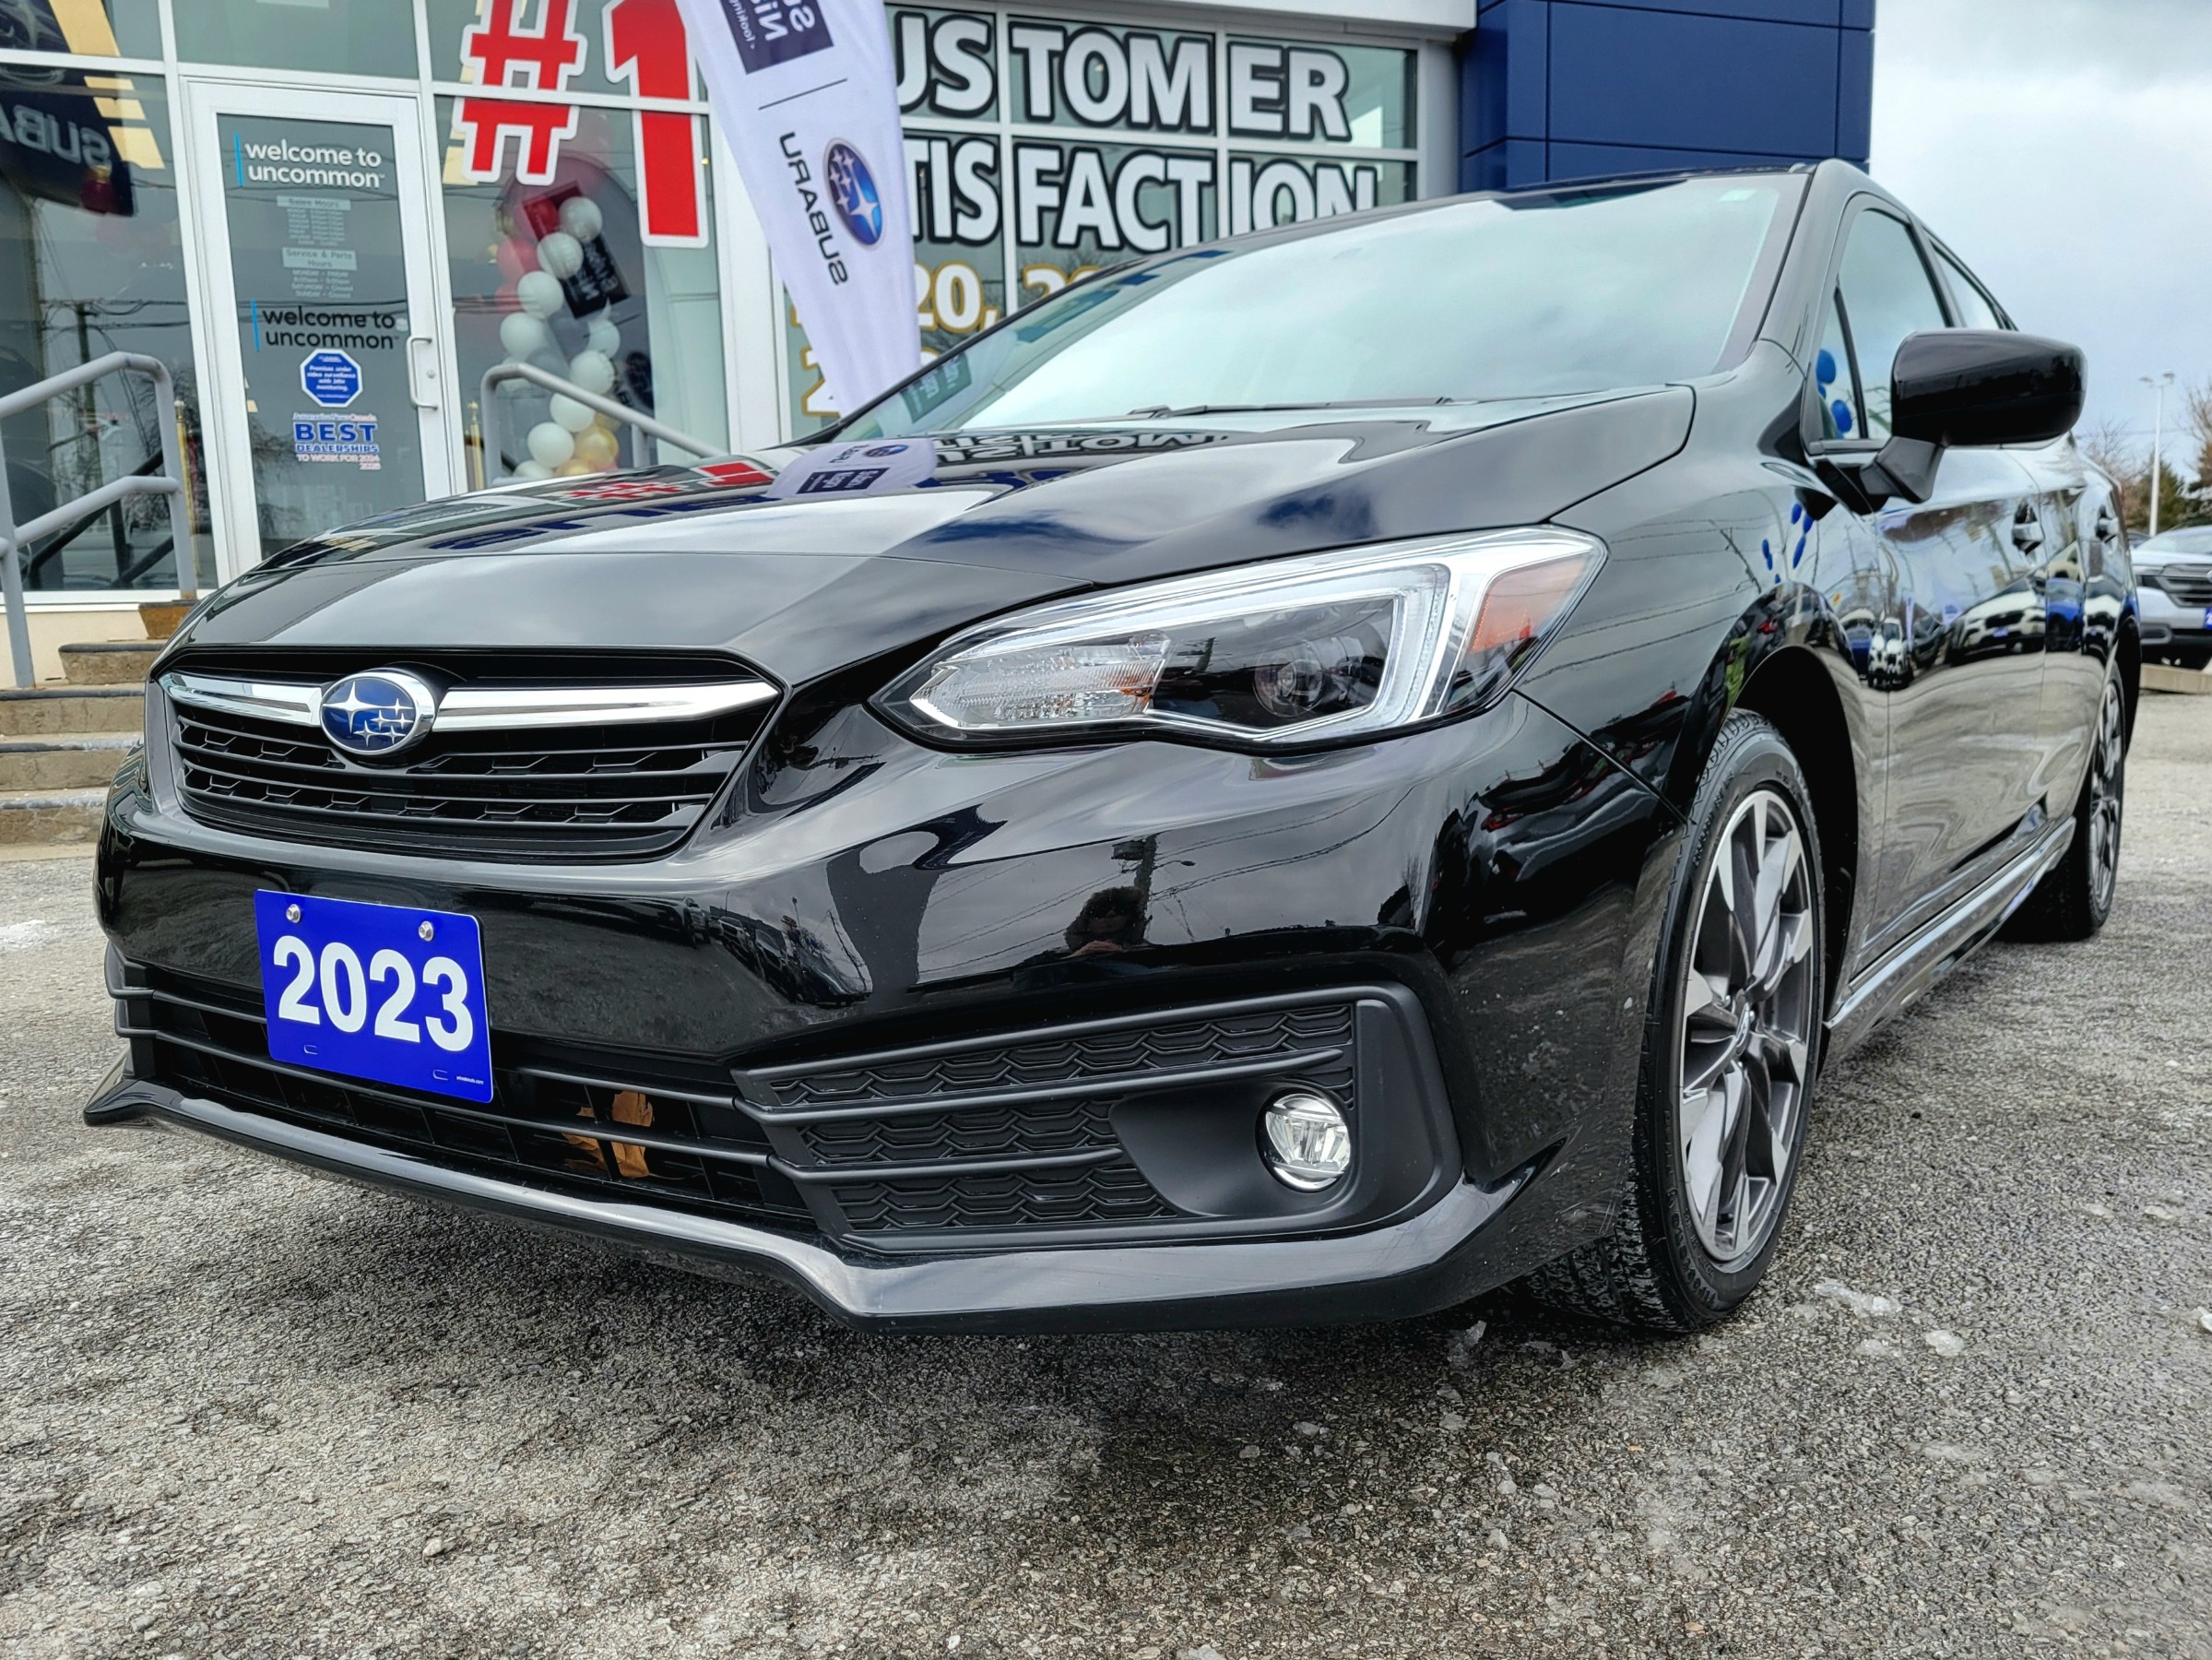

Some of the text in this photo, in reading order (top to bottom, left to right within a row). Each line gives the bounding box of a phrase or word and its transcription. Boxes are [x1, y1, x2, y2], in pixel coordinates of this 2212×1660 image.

[895, 11, 1352, 141] USTOMER
[244, 138, 383, 168] welcome to
[247, 164, 381, 188] uncommon
[902, 134, 1377, 254] TISFACTION
[263, 305, 396, 329] welcome to
[266, 330, 395, 350] uncommon
[294, 422, 377, 443] BEST
[296, 444, 379, 454] DEALERSHIPS
[297, 454, 310, 462] TO
[273, 934, 474, 1052] 2023
